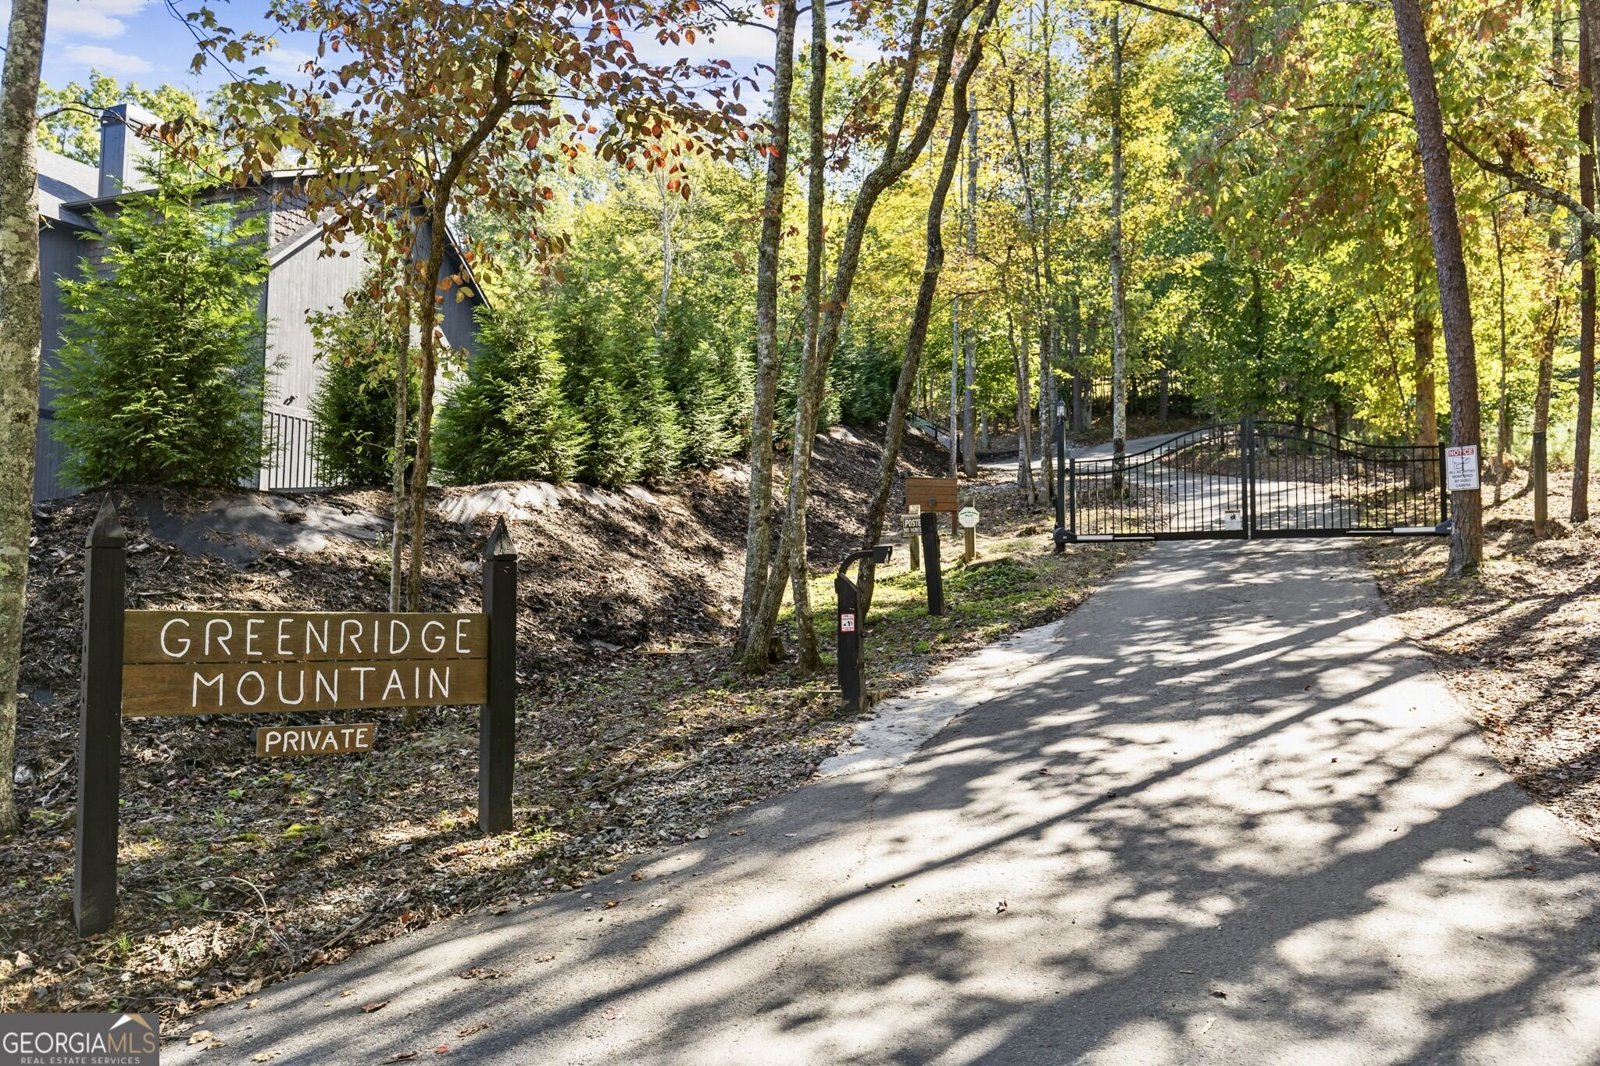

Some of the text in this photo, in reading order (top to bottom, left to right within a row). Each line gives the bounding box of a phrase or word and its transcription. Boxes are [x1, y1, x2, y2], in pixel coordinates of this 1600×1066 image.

[1449, 448, 1473, 457] NOTICE
[904, 519, 921, 527] POSTE
[160, 618, 471, 658] GREENRIDGE
[192, 666, 450, 707] MOUNTAIN
[265, 728, 369, 753] PRIVATE
